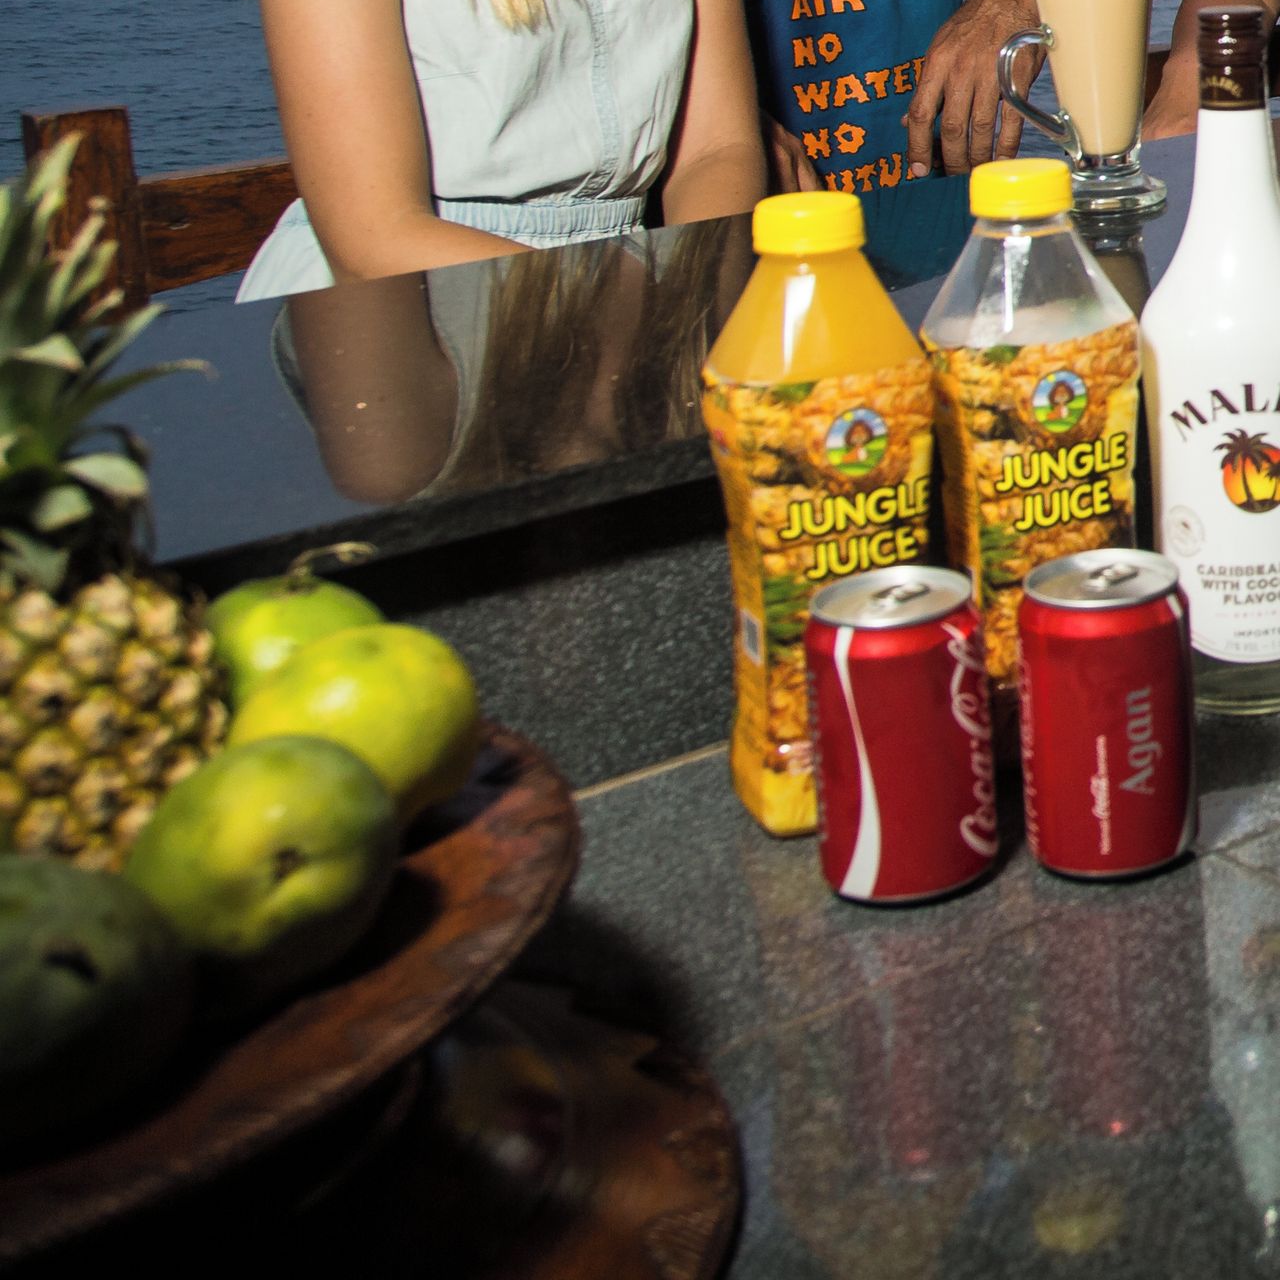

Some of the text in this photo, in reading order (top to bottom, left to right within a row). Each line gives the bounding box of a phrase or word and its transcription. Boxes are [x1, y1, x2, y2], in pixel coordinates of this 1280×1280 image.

[792, 32, 843, 68] NO
[802, 122, 866, 159] NO
[824, 153, 914, 194] UTU
[995, 432, 1127, 492] JUNGLE
[779, 477, 929, 540] JUNGLE
[1014, 478, 1112, 532] JUICE
[806, 526, 919, 580] JUICE
[1202, 579, 1240, 591] WITH
[1120, 687, 1163, 795] Agan
